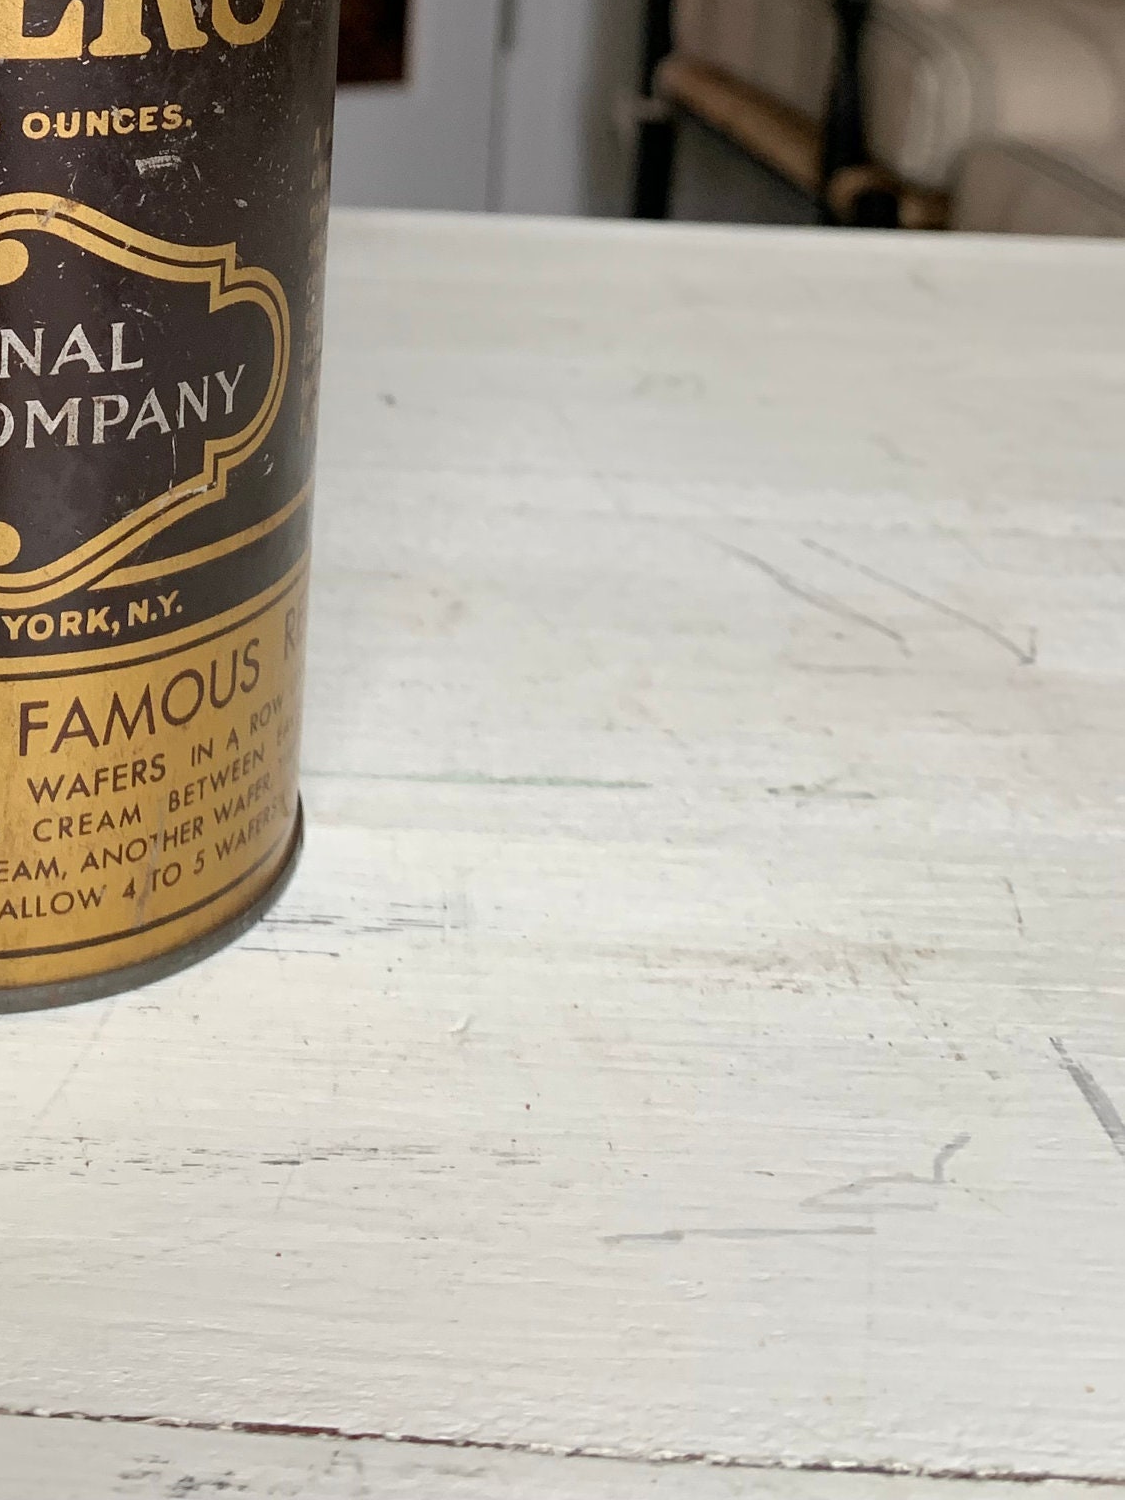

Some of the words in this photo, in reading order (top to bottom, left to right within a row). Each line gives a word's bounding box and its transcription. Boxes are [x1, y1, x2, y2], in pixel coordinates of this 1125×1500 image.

[21, 104, 193, 140] OUNCES.
[18, 637, 261, 757] FAMOUS
[26, 753, 167, 805] WAFERS
[190, 736, 214, 767] IN
[225, 726, 240, 752] A
[32, 803, 143, 844] CREAM
[167, 744, 266, 813] BETWEEN
[80, 815, 204, 874] ANOTHER
[121, 876, 137, 900] 4
[150, 861, 182, 892] TO
[193, 848, 205, 876] 5
